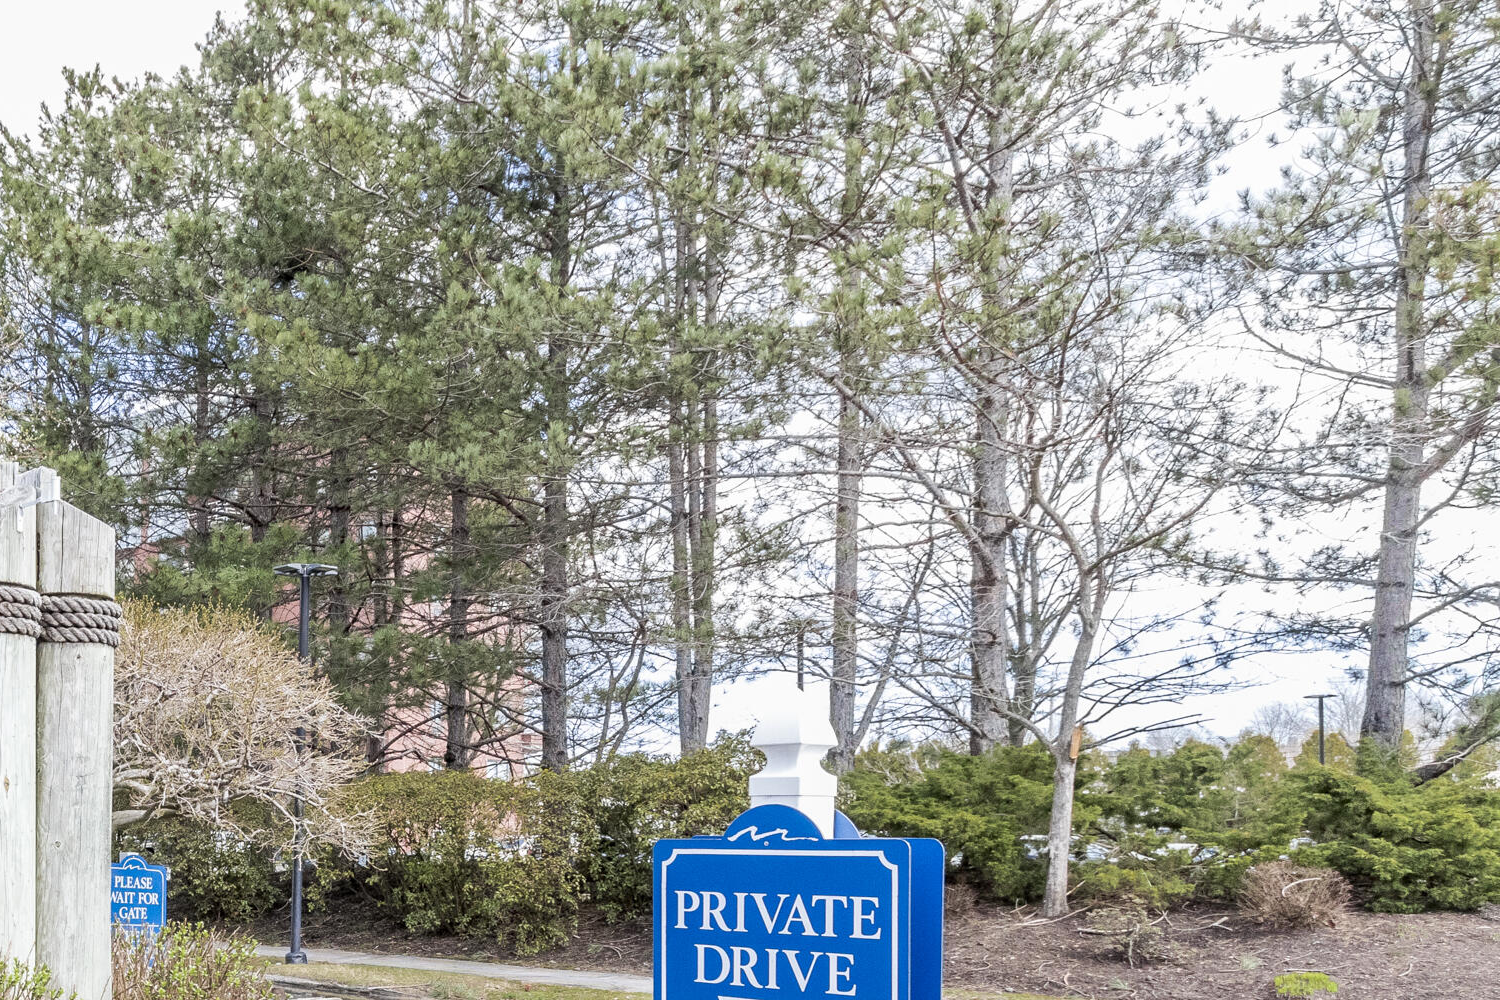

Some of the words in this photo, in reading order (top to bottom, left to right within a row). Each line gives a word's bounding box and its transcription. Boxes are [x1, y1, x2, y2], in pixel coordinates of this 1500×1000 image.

[114, 875, 153, 890] PLEASE
[138, 892, 159, 905] FOR
[118, 906, 148, 920] GATE
[674, 890, 882, 940] PRIVATE
[693, 943, 857, 997] DRIVE
